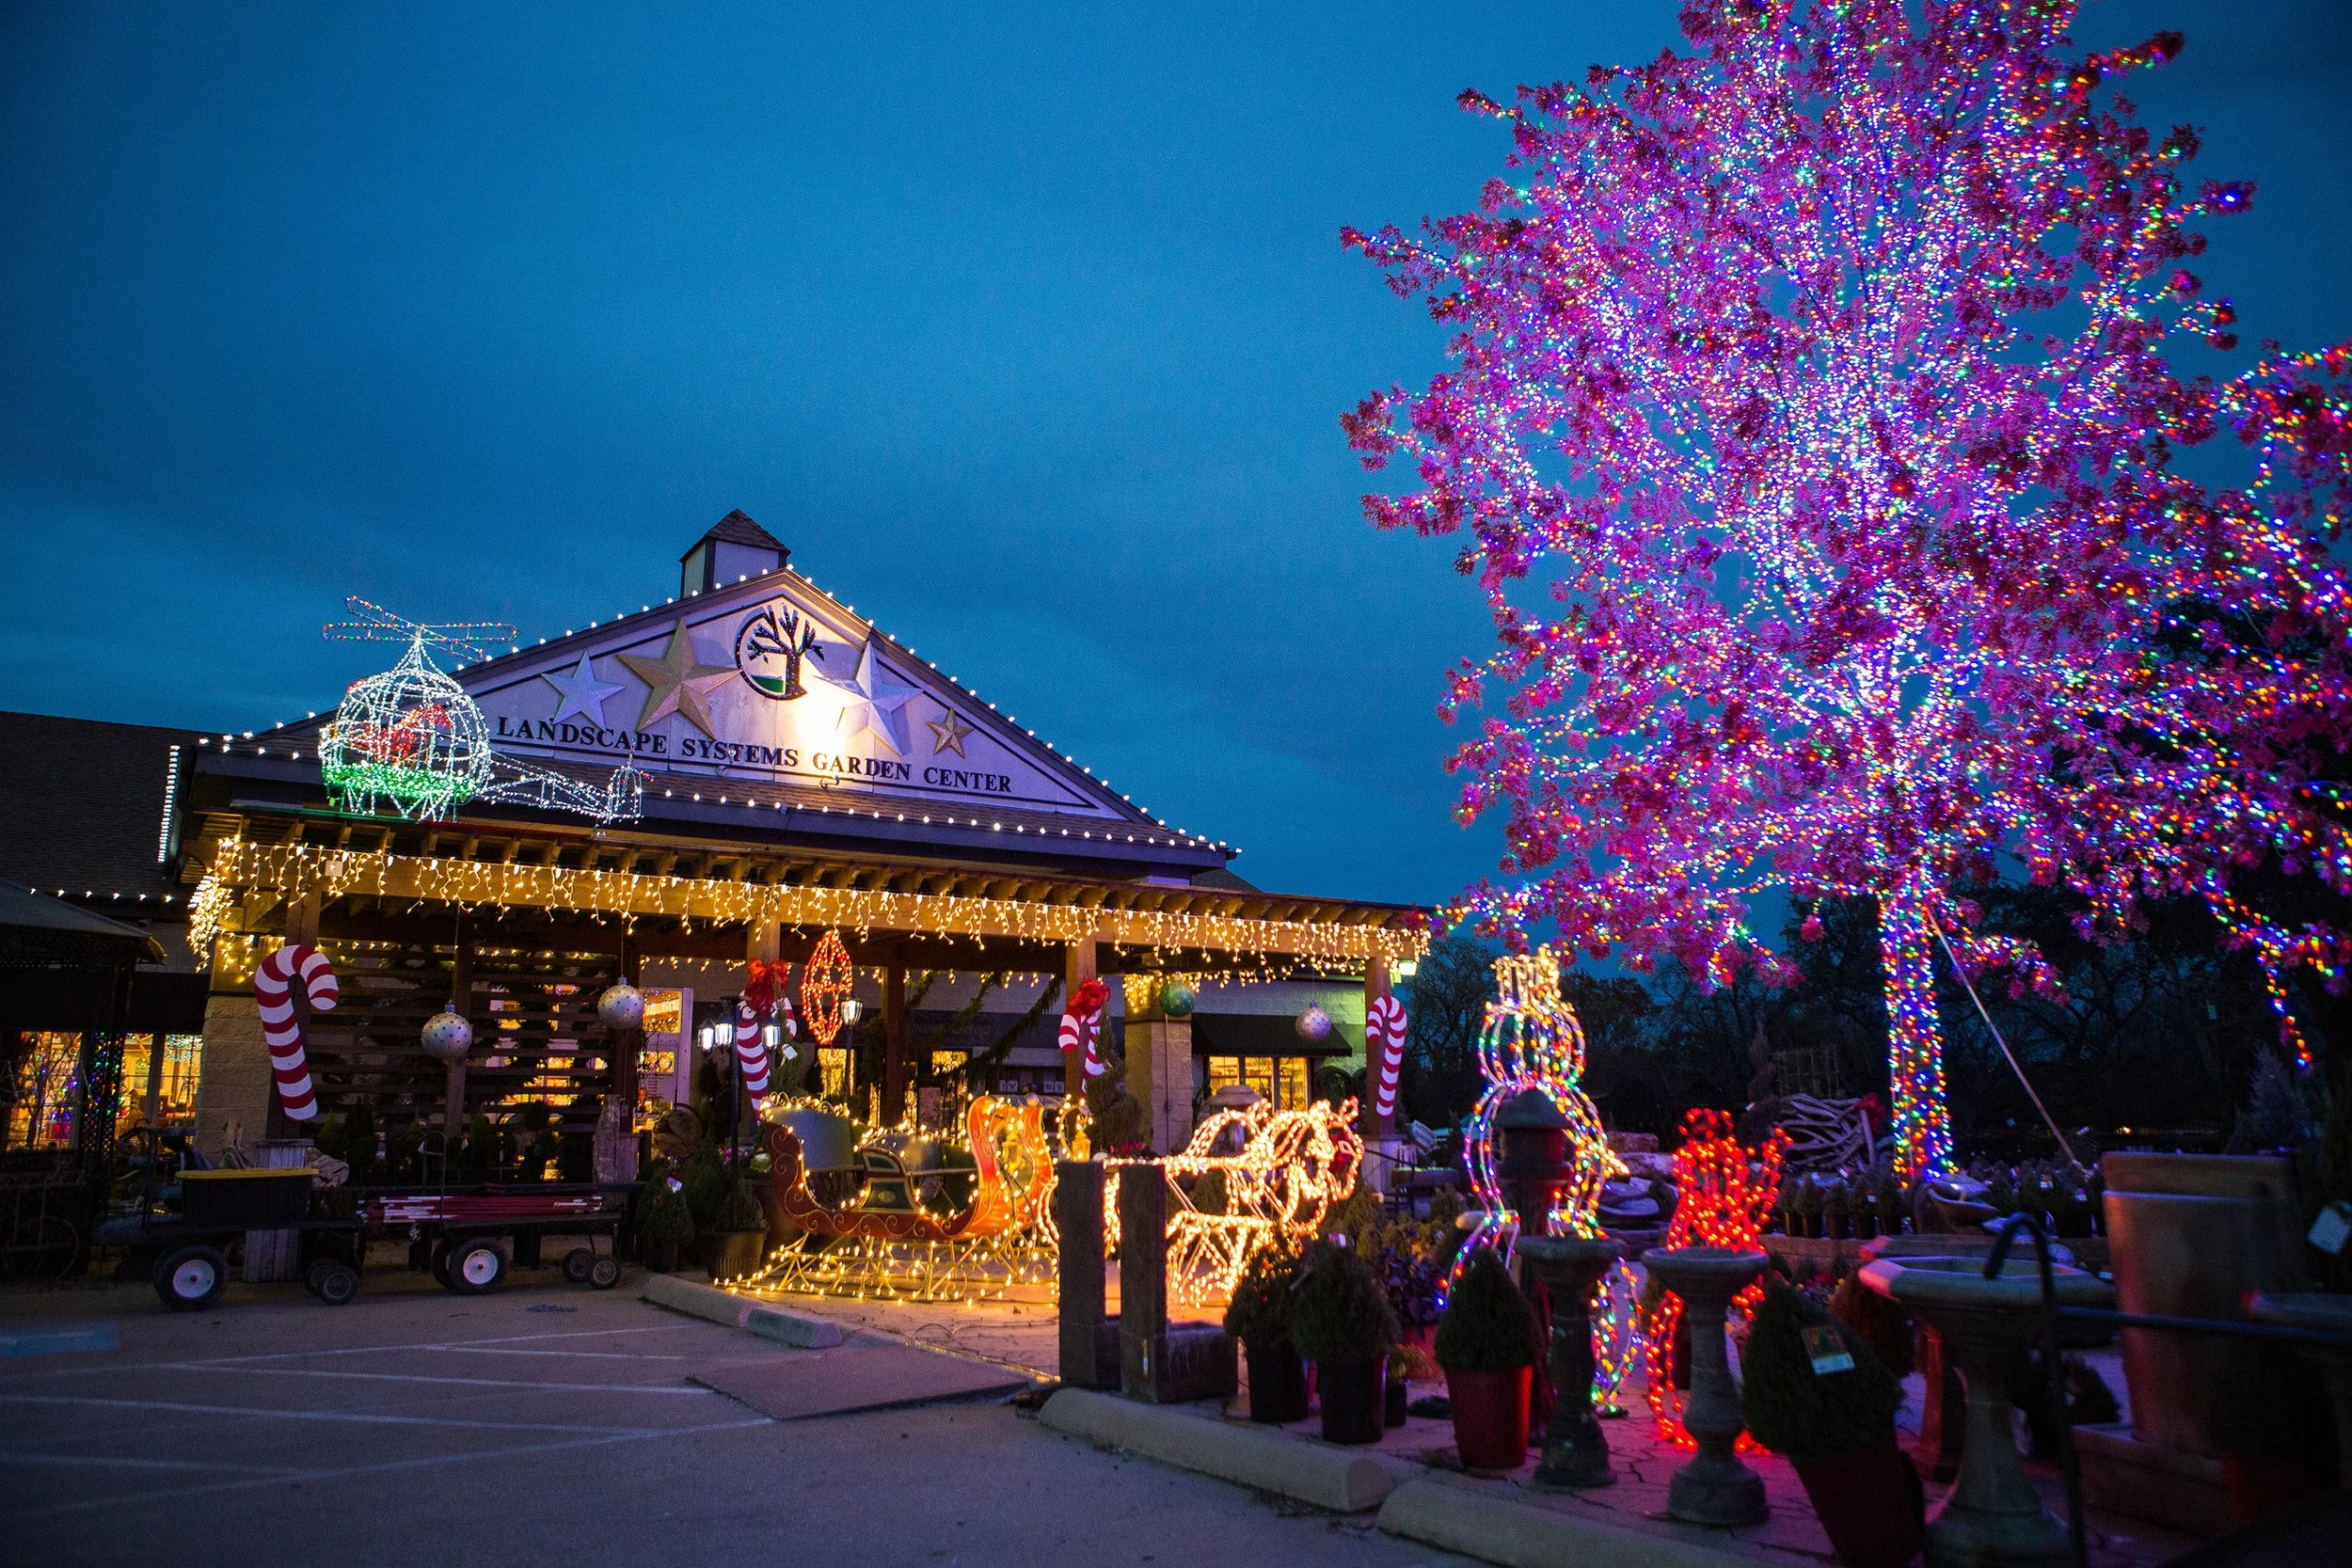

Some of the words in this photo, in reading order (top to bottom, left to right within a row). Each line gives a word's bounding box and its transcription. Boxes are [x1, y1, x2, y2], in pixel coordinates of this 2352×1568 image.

[497, 716, 668, 754] LANDSCAPE
[681, 737, 799, 767] SYSTEMS
[812, 752, 912, 782] GARDEN
[923, 766, 1013, 793] CENTER
